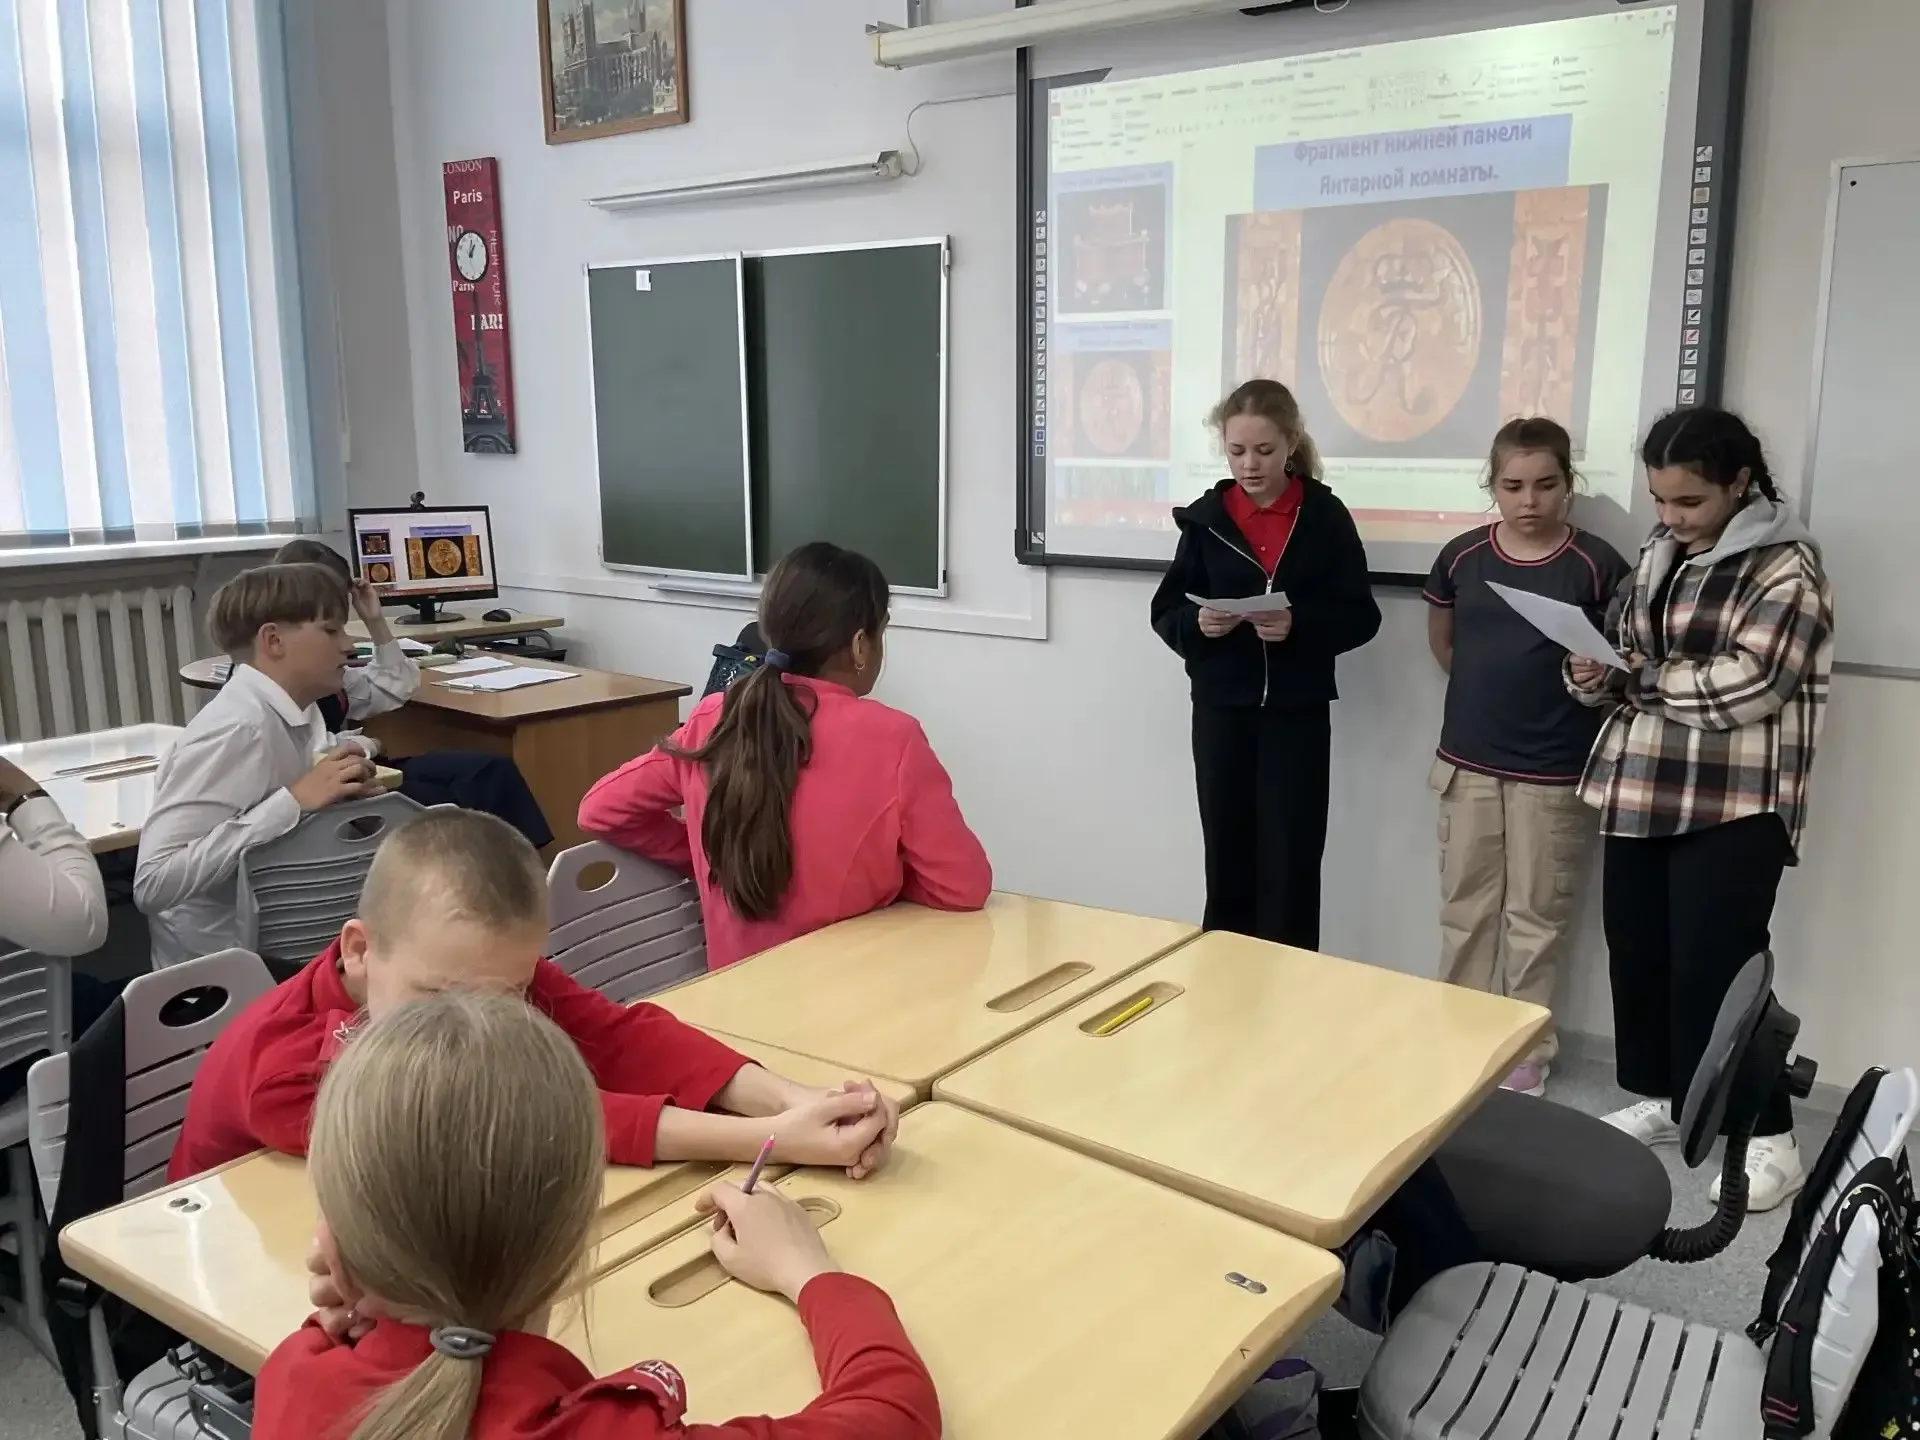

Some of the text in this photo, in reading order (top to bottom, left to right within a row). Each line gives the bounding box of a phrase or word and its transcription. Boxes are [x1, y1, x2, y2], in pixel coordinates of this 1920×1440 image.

[1294, 124, 1532, 166] Фрагмент нижней панели
[1321, 164, 1500, 196] Янтарной комнаты.
[453, 189, 482, 204] Paris
[453, 280, 475, 292] Paris
